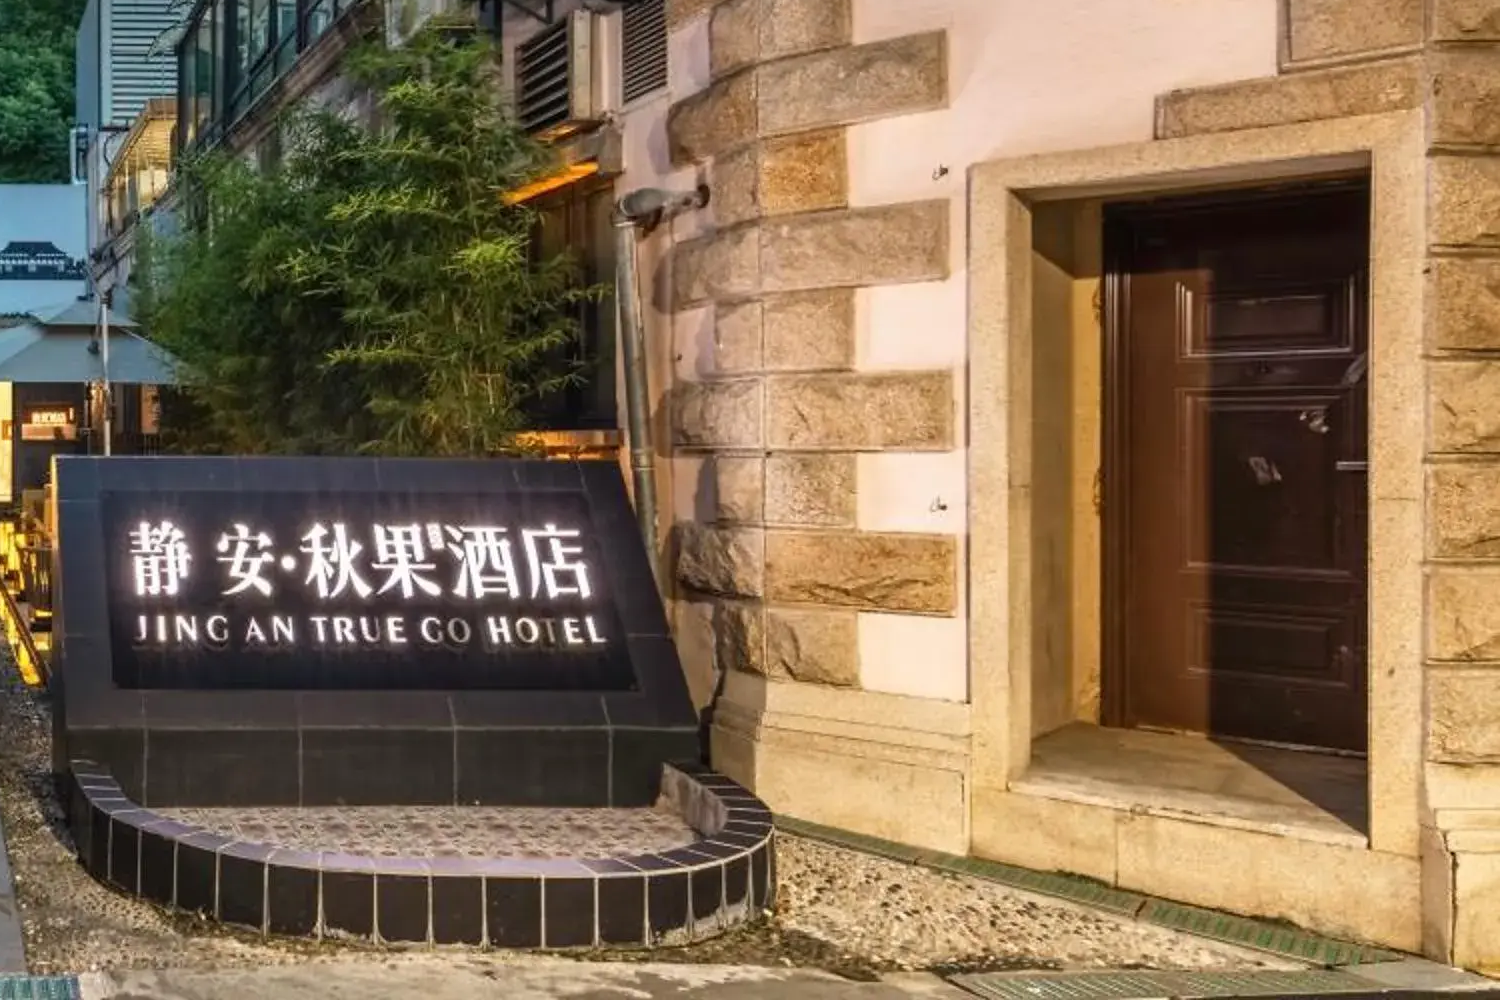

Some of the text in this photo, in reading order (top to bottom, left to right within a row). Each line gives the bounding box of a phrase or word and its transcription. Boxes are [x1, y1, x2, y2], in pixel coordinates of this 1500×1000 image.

[134, 614, 607, 645] JING AN TRUE GO HOTEL
